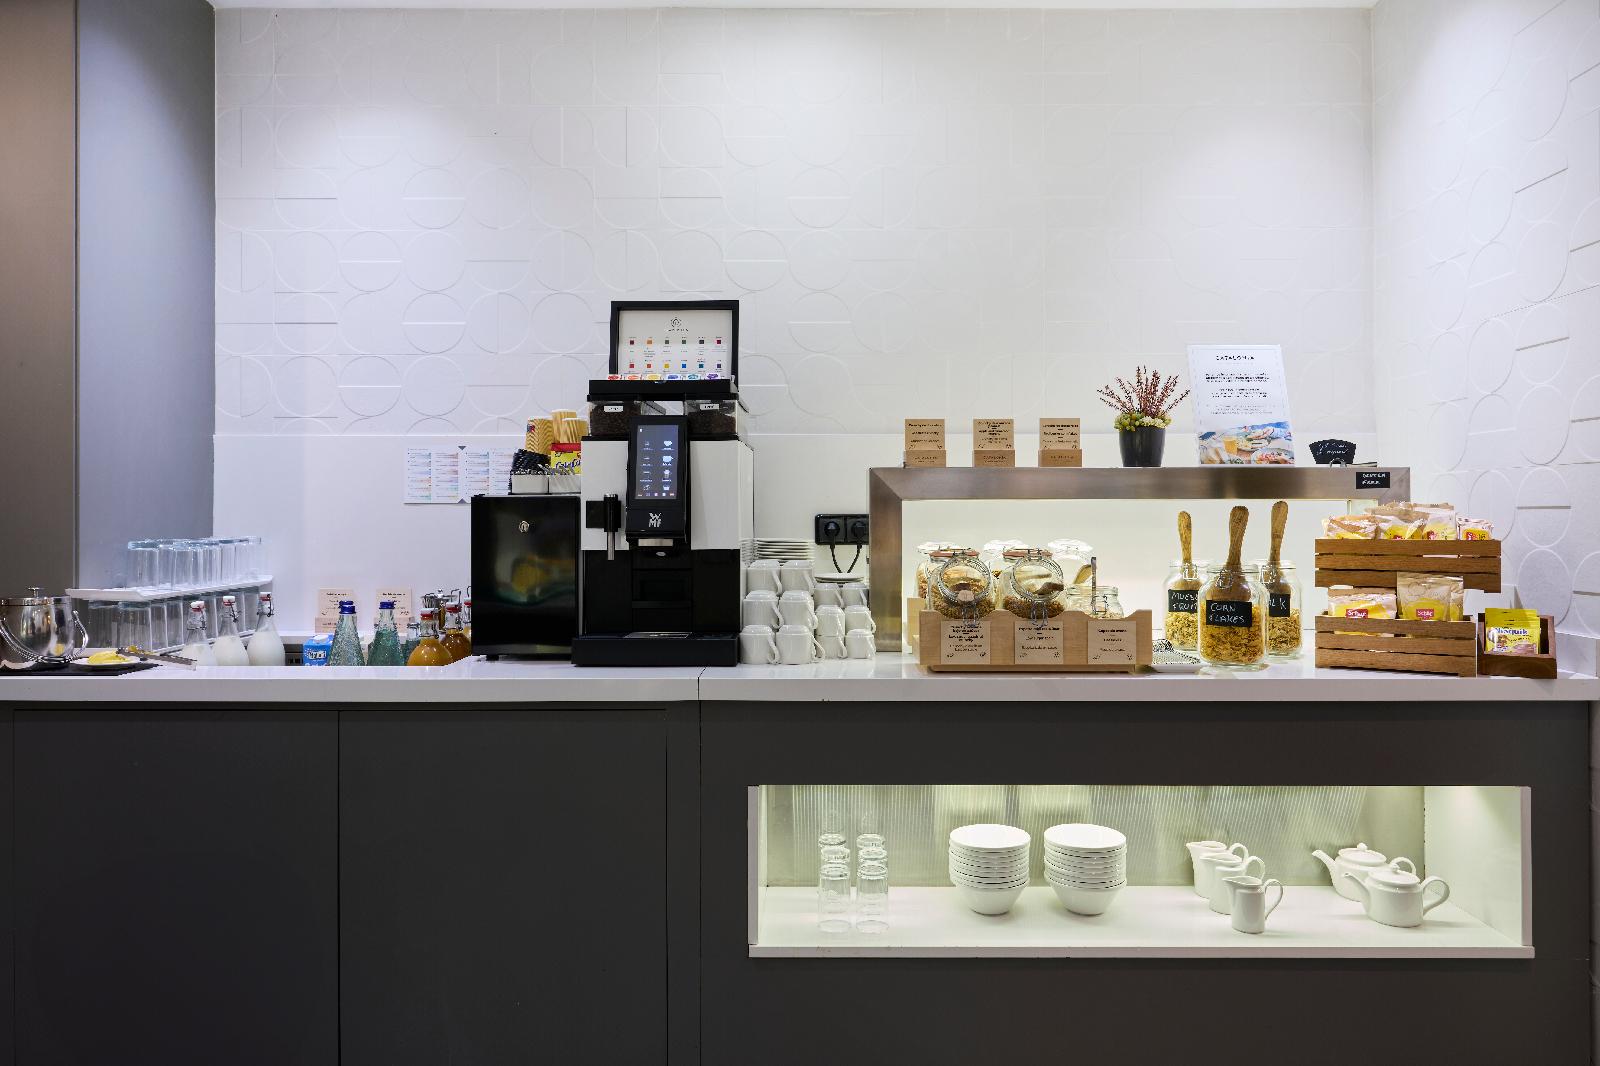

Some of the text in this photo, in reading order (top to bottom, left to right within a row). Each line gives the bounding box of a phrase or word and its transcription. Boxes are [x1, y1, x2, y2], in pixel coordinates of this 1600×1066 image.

[1210, 602, 1236, 612] CORN
[1208, 613, 1245, 623] FLAKES
[1495, 627, 1528, 635] Nesquik
